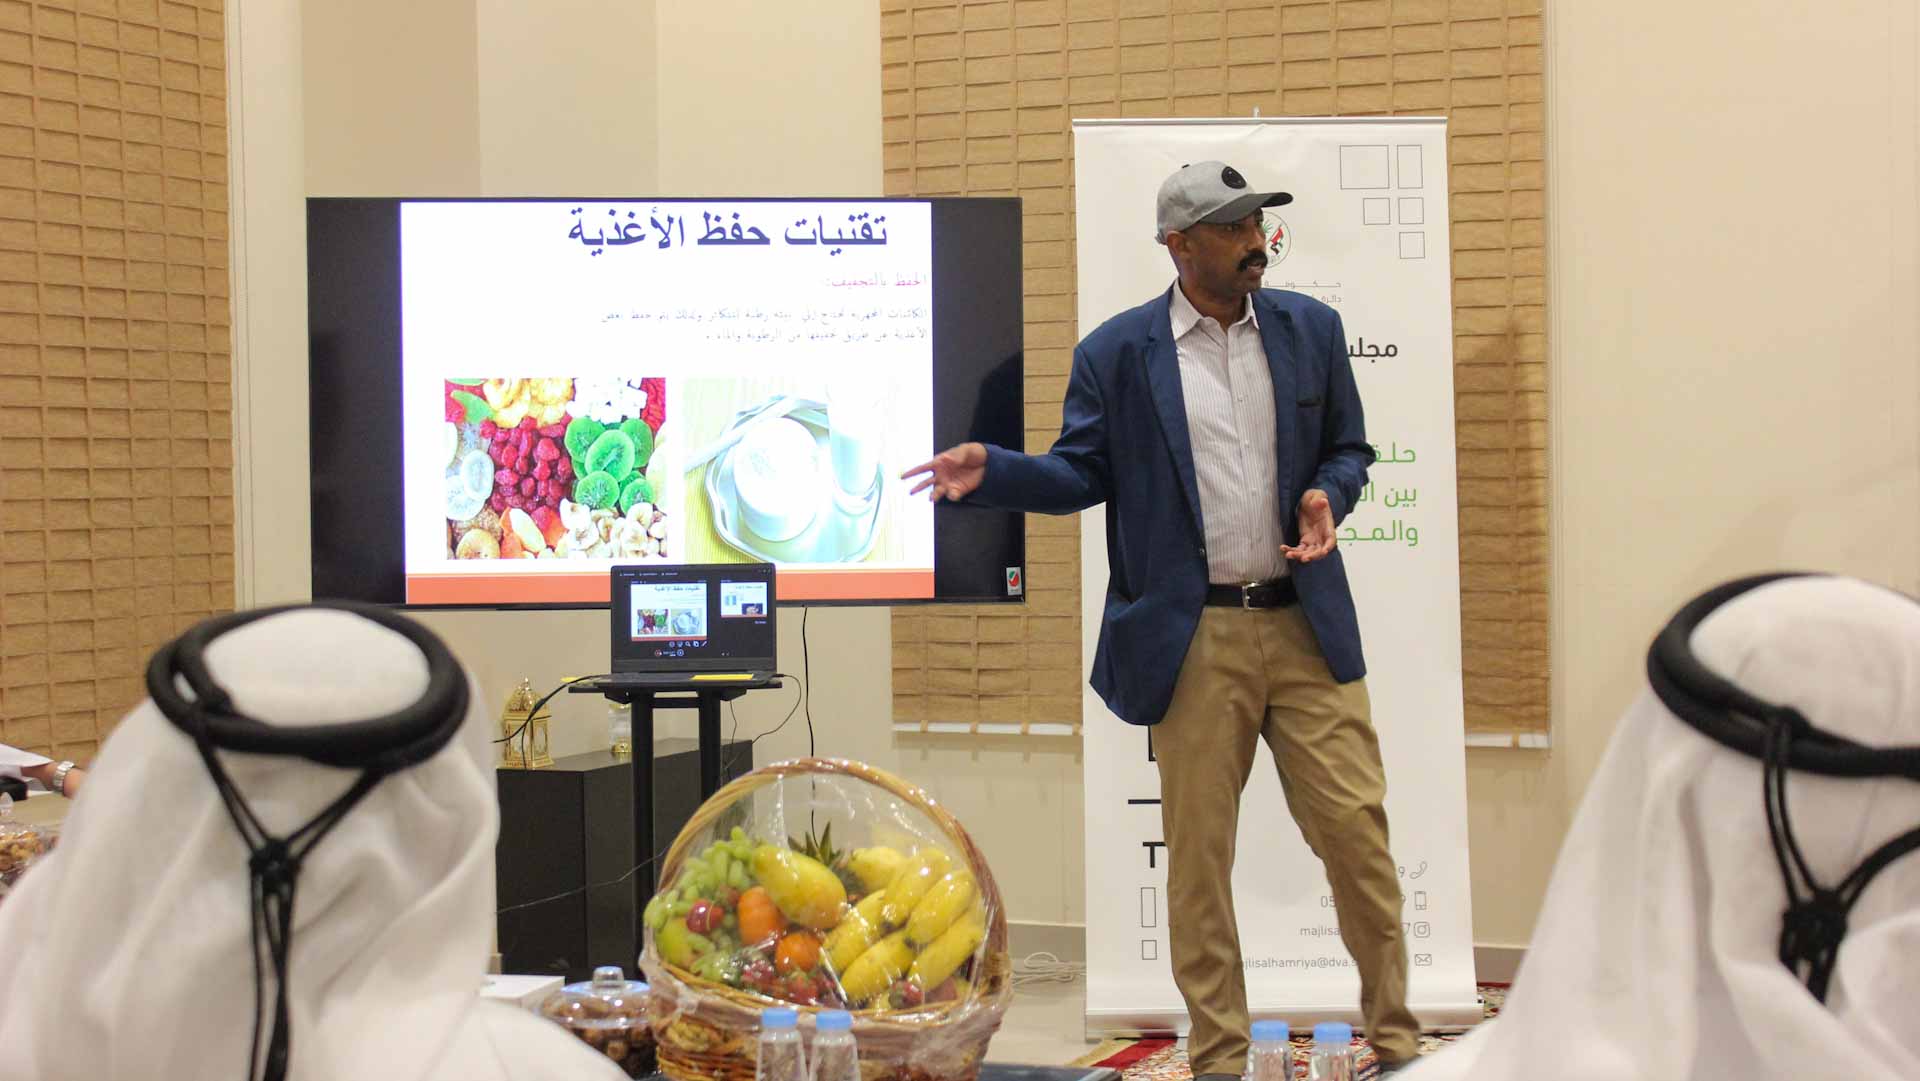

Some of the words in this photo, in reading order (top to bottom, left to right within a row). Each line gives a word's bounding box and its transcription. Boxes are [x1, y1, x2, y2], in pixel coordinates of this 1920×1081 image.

[568, 206, 685, 257] الأغذية
[697, 210, 771, 246] حفظ
[785, 209, 888, 256] تقنيات
[894, 272, 927, 287] الحفظ
[1384, 486, 1417, 508] بين
